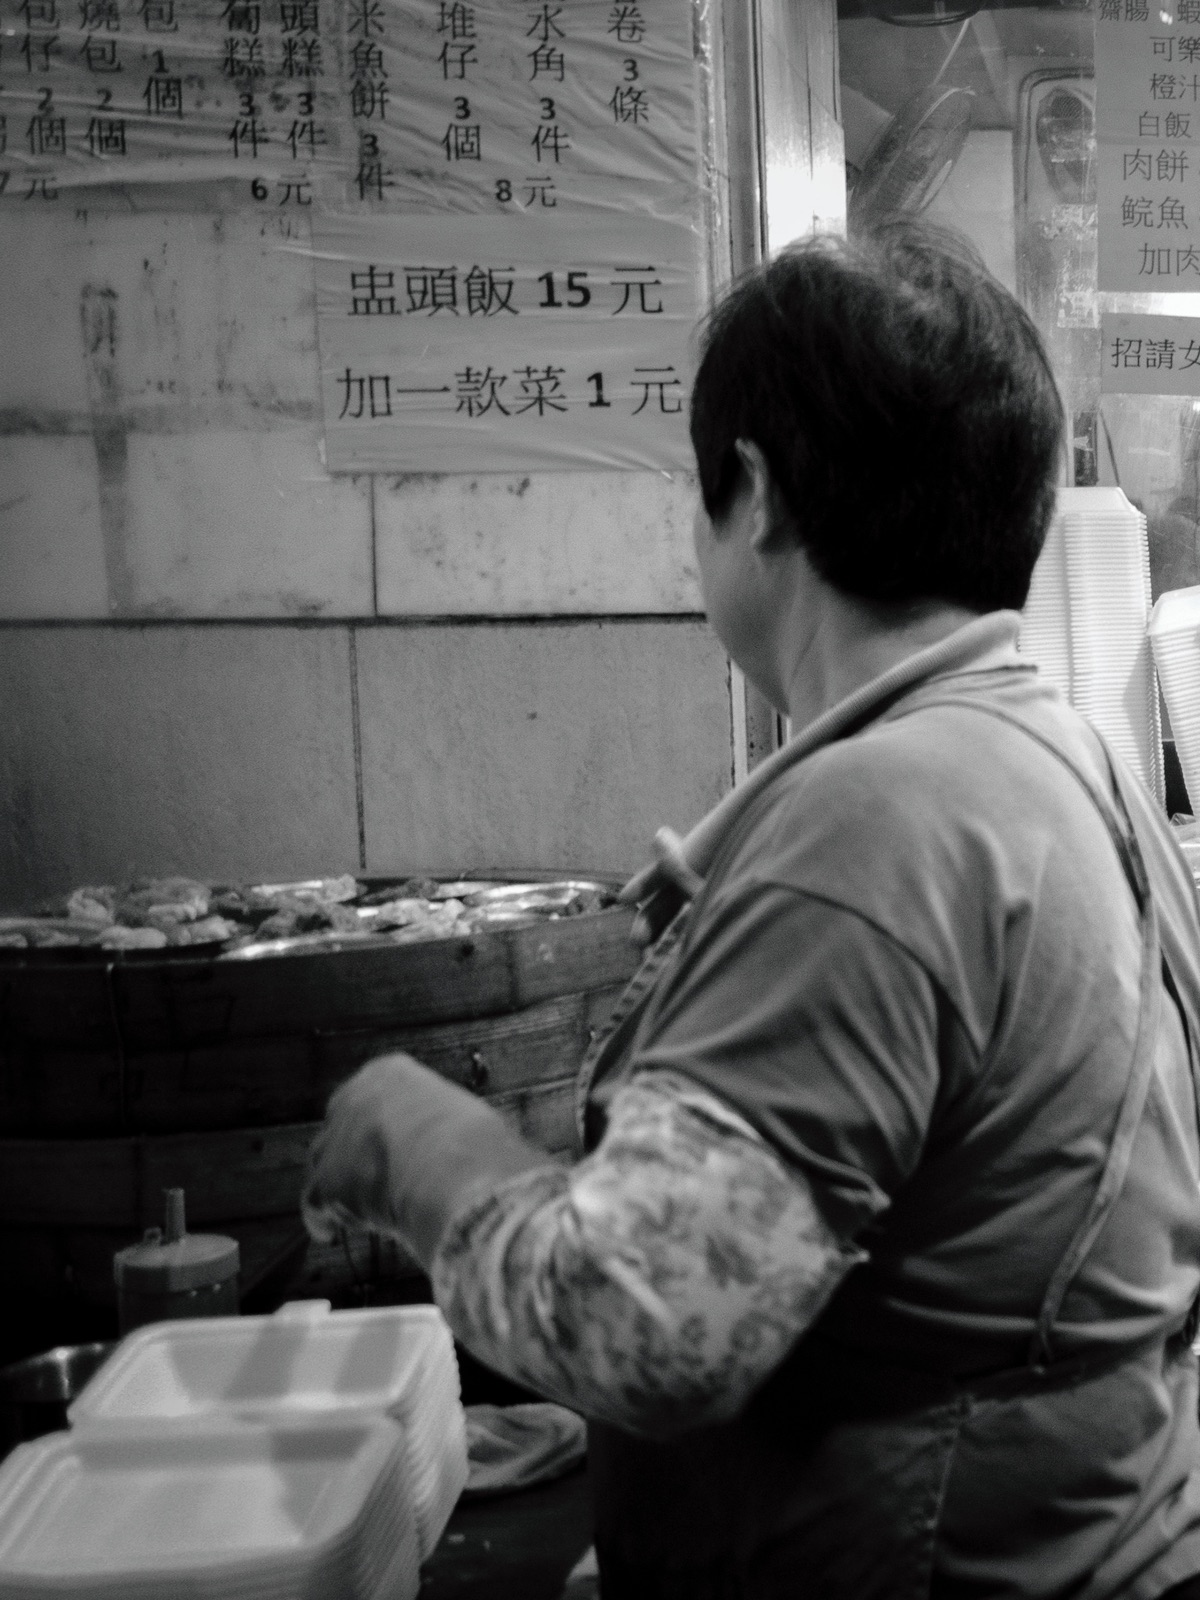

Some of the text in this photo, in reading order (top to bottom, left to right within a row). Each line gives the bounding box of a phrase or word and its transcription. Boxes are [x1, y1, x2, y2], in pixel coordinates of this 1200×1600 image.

[1138, 111, 1192, 139] 白飯
[1123, 148, 1189, 183] 肉餅
[251, 173, 312, 206] 6 元
[495, 176, 557, 208] 8 元
[347, 265, 664, 318] 盅頭飯 15 元
[336, 366, 683, 420] 加一款菜 1 元
